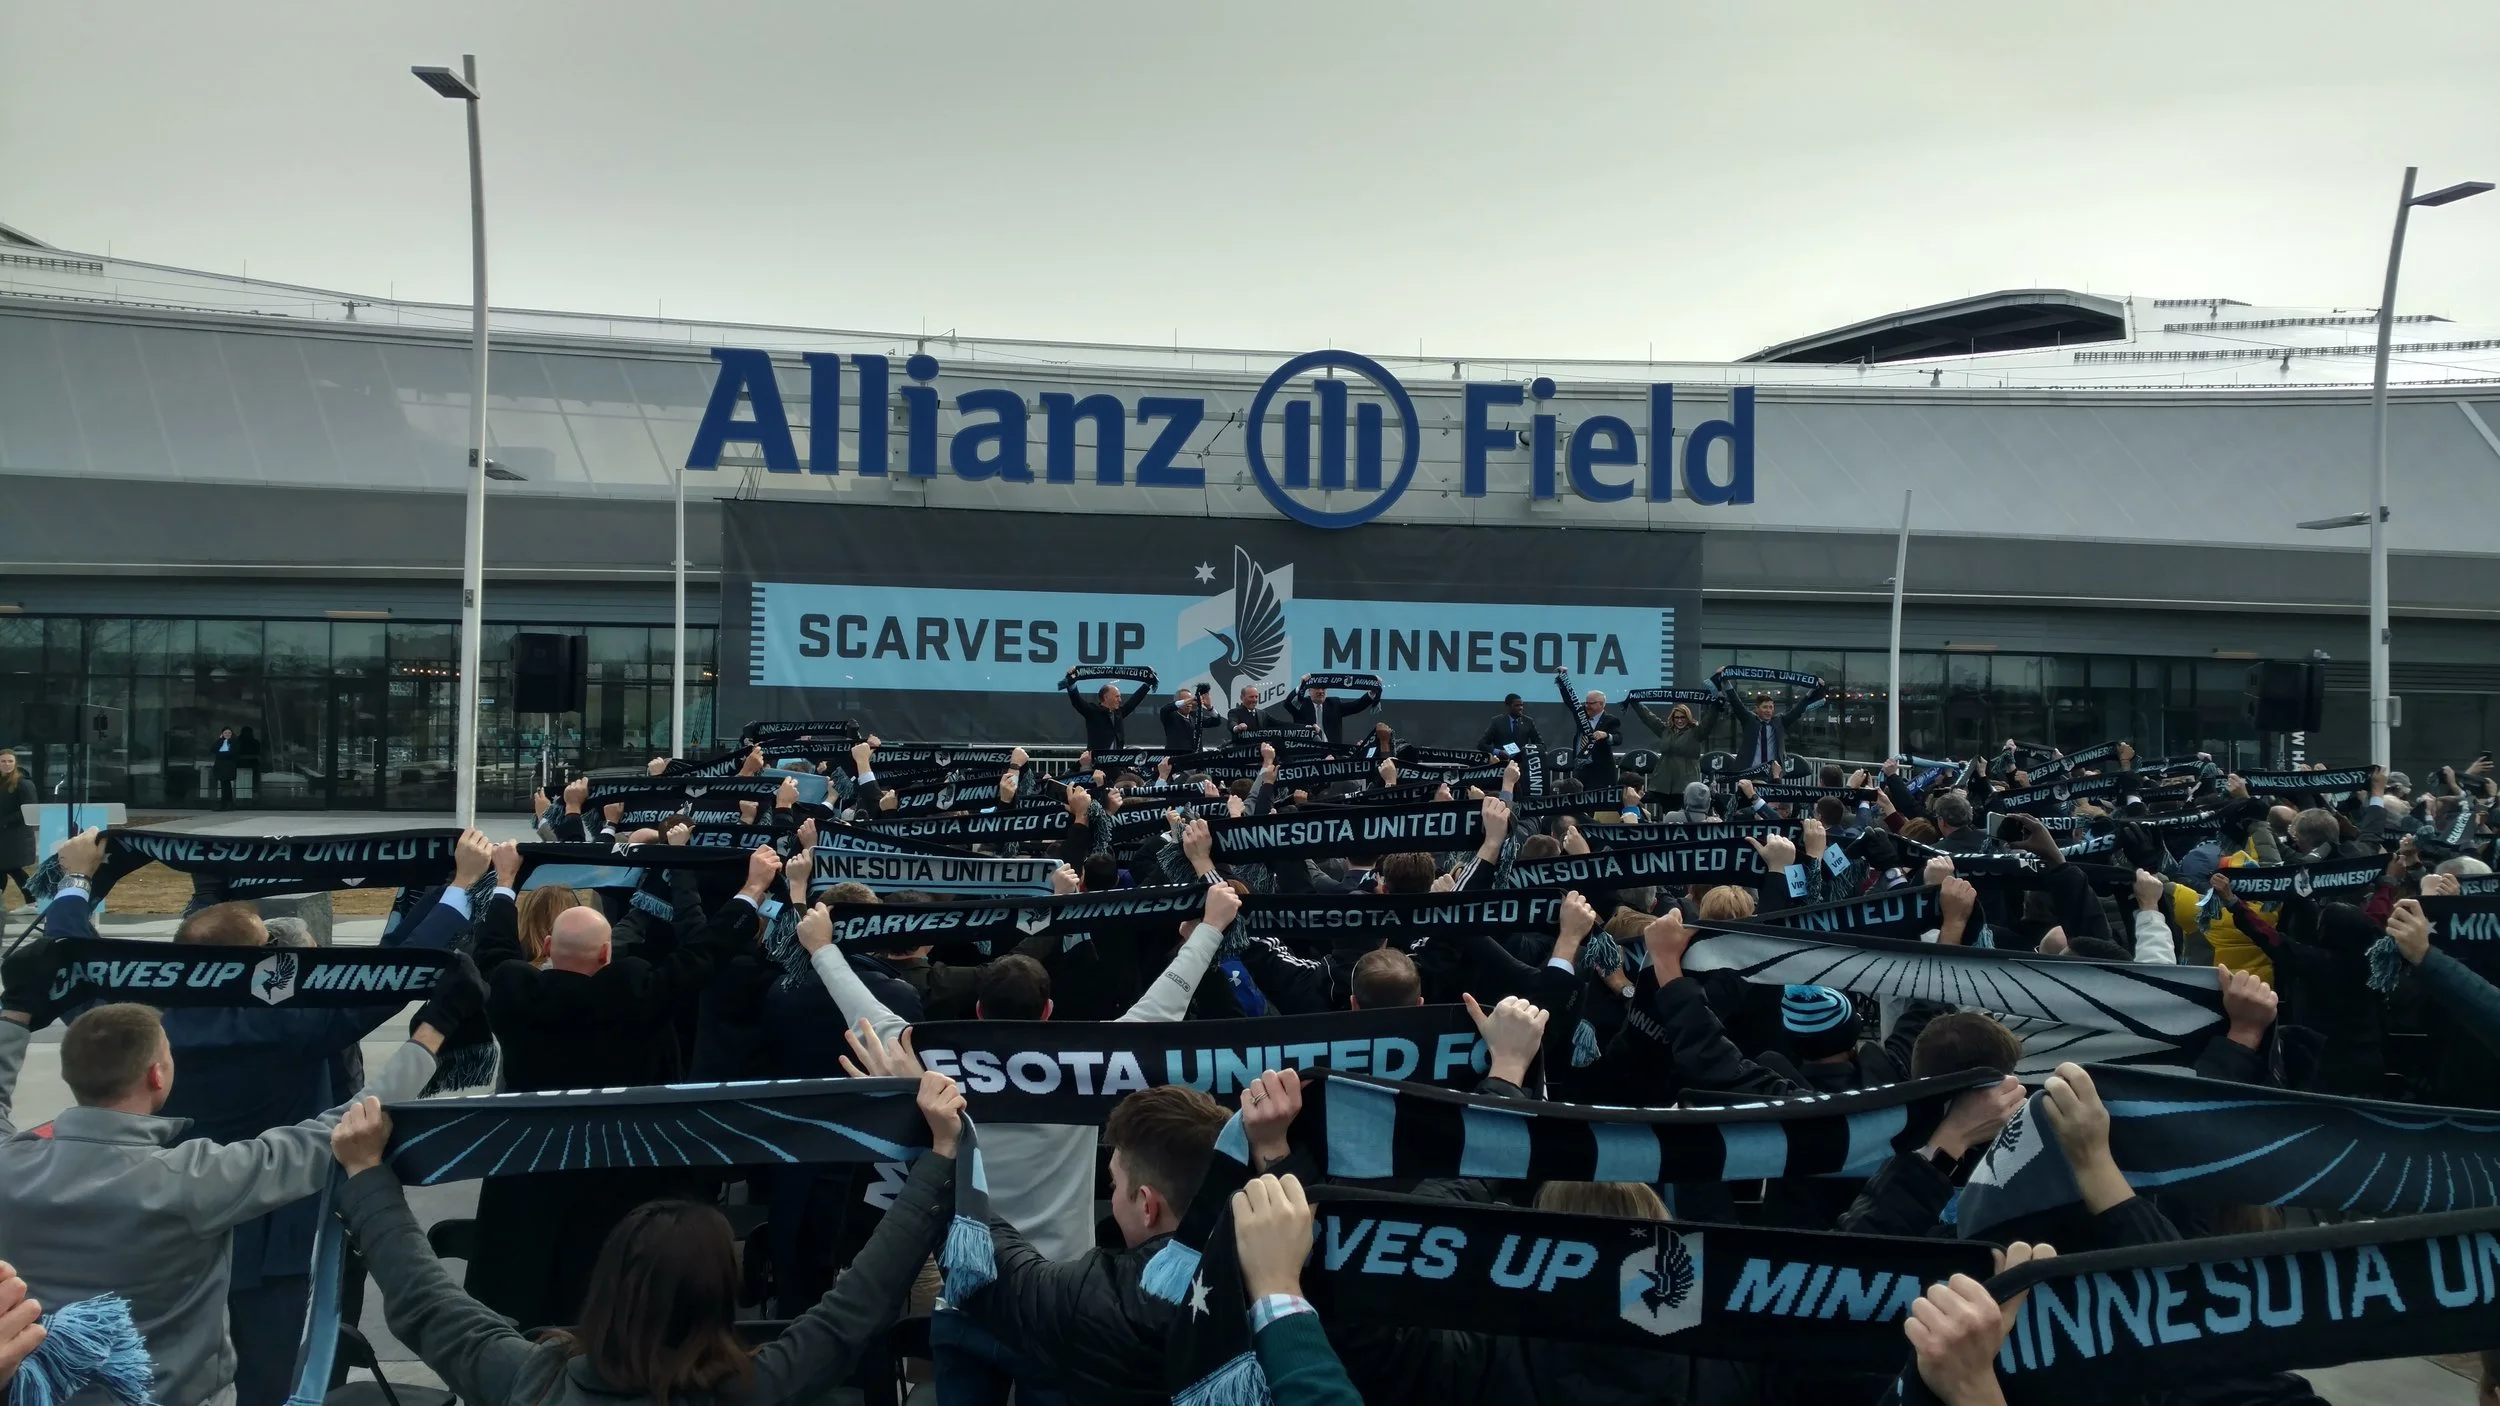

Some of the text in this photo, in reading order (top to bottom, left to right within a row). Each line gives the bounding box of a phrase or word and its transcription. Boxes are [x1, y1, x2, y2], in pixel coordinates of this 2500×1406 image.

[685, 347, 1755, 506] Allianz Field
[799, 613, 1629, 676] SCARVES UP MINNESOTA
[1077, 666, 1149, 678] MINNESOTA UNITED FC
[1721, 668, 1815, 685] MINNESOTA UNITED
[1330, 677, 1342, 685] UP
[1629, 690, 1673, 699] MINNESOTA
[1675, 690, 1704, 701] UNITED
[758, 722, 805, 735] INNESOTA
[1284, 729, 1310, 738] UNITED
[2292, 731, 2305, 746] W
[871, 751, 910, 763] ARVES
[912, 750, 931, 761] UP
[1121, 754, 1134, 763] UP
[2048, 761, 2061, 770] UP
[2074, 745, 2112, 764] MINNES
[1277, 760, 1371, 781] ESOTA UNITED
[1421, 770, 1439, 781] UP
[1462, 768, 1504, 780] MINNE
[1528, 756, 1543, 796] UNITED
[2307, 772, 2350, 786] UNITED
[912, 792, 935, 807] UP
[956, 785, 999, 801] MINN
[1754, 786, 1802, 797] NNESOTA
[2033, 788, 2050, 800] UP
[619, 810, 658, 824] CARVES
[692, 810, 740, 824] MINNES
[968, 814, 1039, 833] UNITED
[1043, 812, 1069, 830] FC
[1216, 810, 1481, 852] MINNESOTA UNITED F
[1586, 826, 1690, 842] NNESOTA
[690, 832, 772, 847] VES UP
[115, 836, 291, 862] MINNESOTA
[303, 837, 416, 862] UNITED
[942, 856, 1034, 883] UNITED
[1042, 862, 1056, 883] F
[1507, 855, 1623, 889] NNESOTA
[1631, 848, 1726, 875] UNITED
[1831, 857, 1844, 868] VIP
[1791, 881, 1805, 890] VIP
[2273, 877, 2292, 892] UP
[2481, 879, 2499, 893] UP
[1244, 907, 1401, 929] MINNESOTA
[1412, 898, 1519, 925] UNITED
[832, 911, 960, 943] SCARVES
[965, 908, 1010, 927] UP
[50, 961, 184, 1001] CARVES
[186, 962, 244, 988] UP
[919, 1050, 1149, 1095] ESOTA
[1166, 1036, 1420, 1095] UNITED
[1318, 1215, 1922, 1323] VES UP MINN
[2000, 1245, 2406, 1375] INNESOTA
